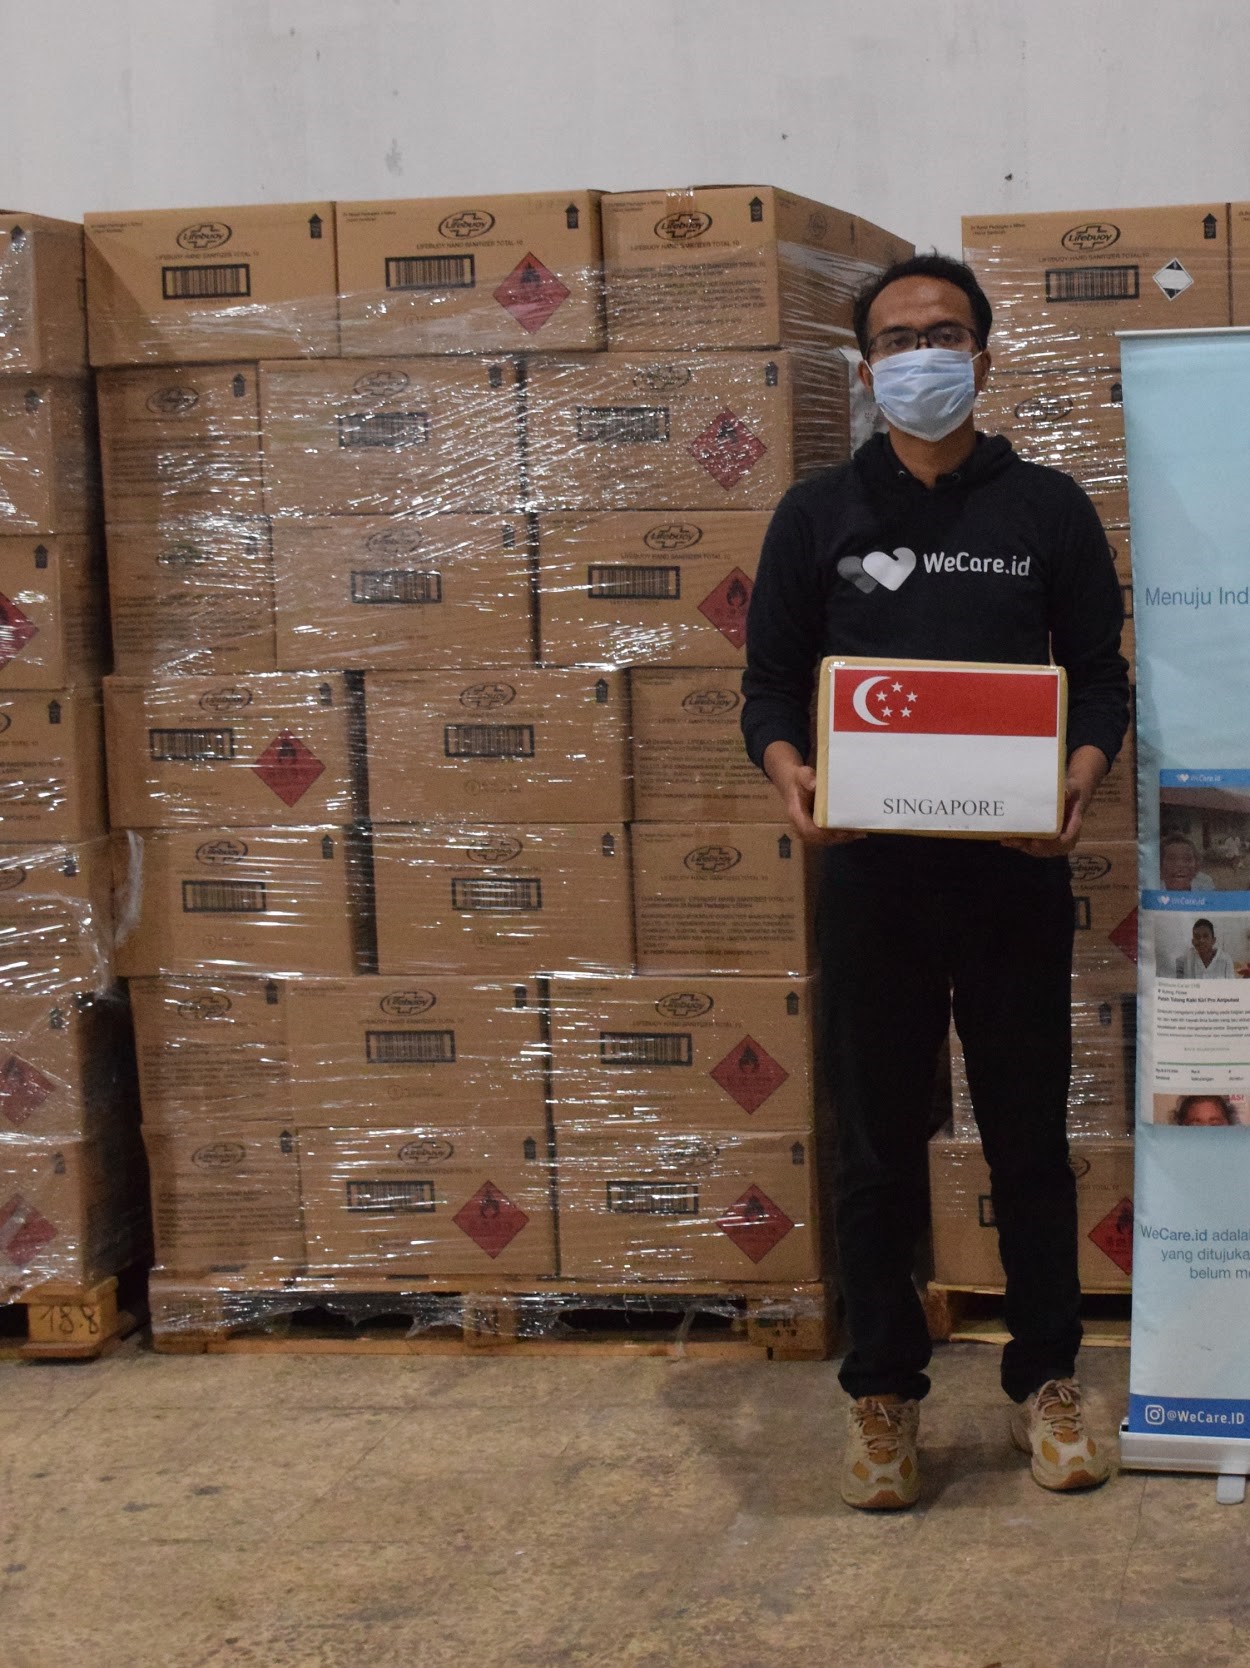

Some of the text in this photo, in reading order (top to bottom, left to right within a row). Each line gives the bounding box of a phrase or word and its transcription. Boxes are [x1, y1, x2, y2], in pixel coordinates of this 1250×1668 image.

[661, 219, 704, 231] Lifebuoy
[1068, 232, 1113, 244] Lifebuoy
[923, 551, 1031, 576] WeCare.id
[1145, 587, 1212, 609] Menuju
[883, 798, 1005, 817] SINGAPORE
[1140, 1224, 1208, 1242] WeCare.id
[1161, 1249, 1193, 1262] yang
[1189, 1266, 1231, 1280] belum
[1166, 1410, 1245, 1425] @WeCare.ID
